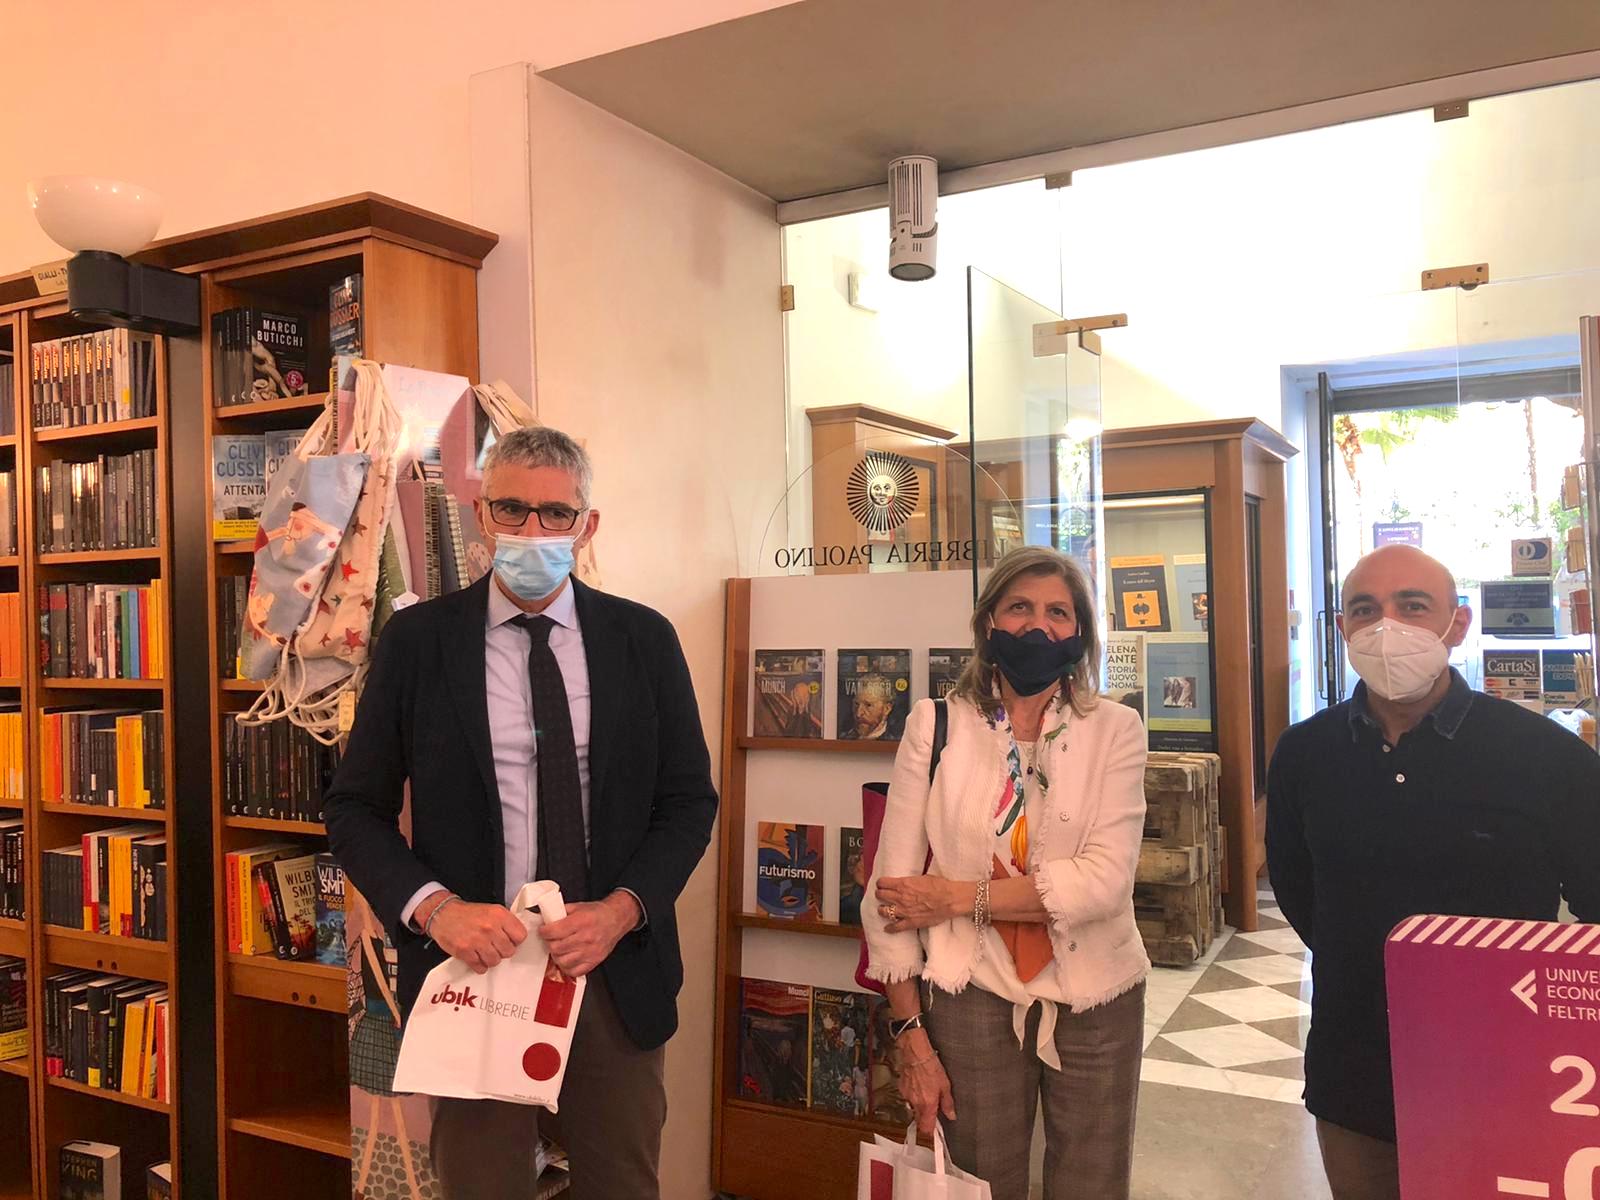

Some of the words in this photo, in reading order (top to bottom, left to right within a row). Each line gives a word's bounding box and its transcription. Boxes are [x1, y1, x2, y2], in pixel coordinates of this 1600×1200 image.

[262, 319, 297, 335] MARCO
[256, 330, 303, 347] BUTICCHI
[223, 484, 266, 496] ATTENTA
[1107, 645, 1137, 653] ELENA
[1107, 654, 1137, 664] ANTE
[761, 679, 786, 694] MUNCH
[759, 864, 816, 880] Futurismo
[1545, 967, 1599, 984] UNIVE
[431, 984, 478, 1012] ubik
[480, 997, 530, 1021] LIBRERIE
[1550, 1055, 1600, 1117] 2
